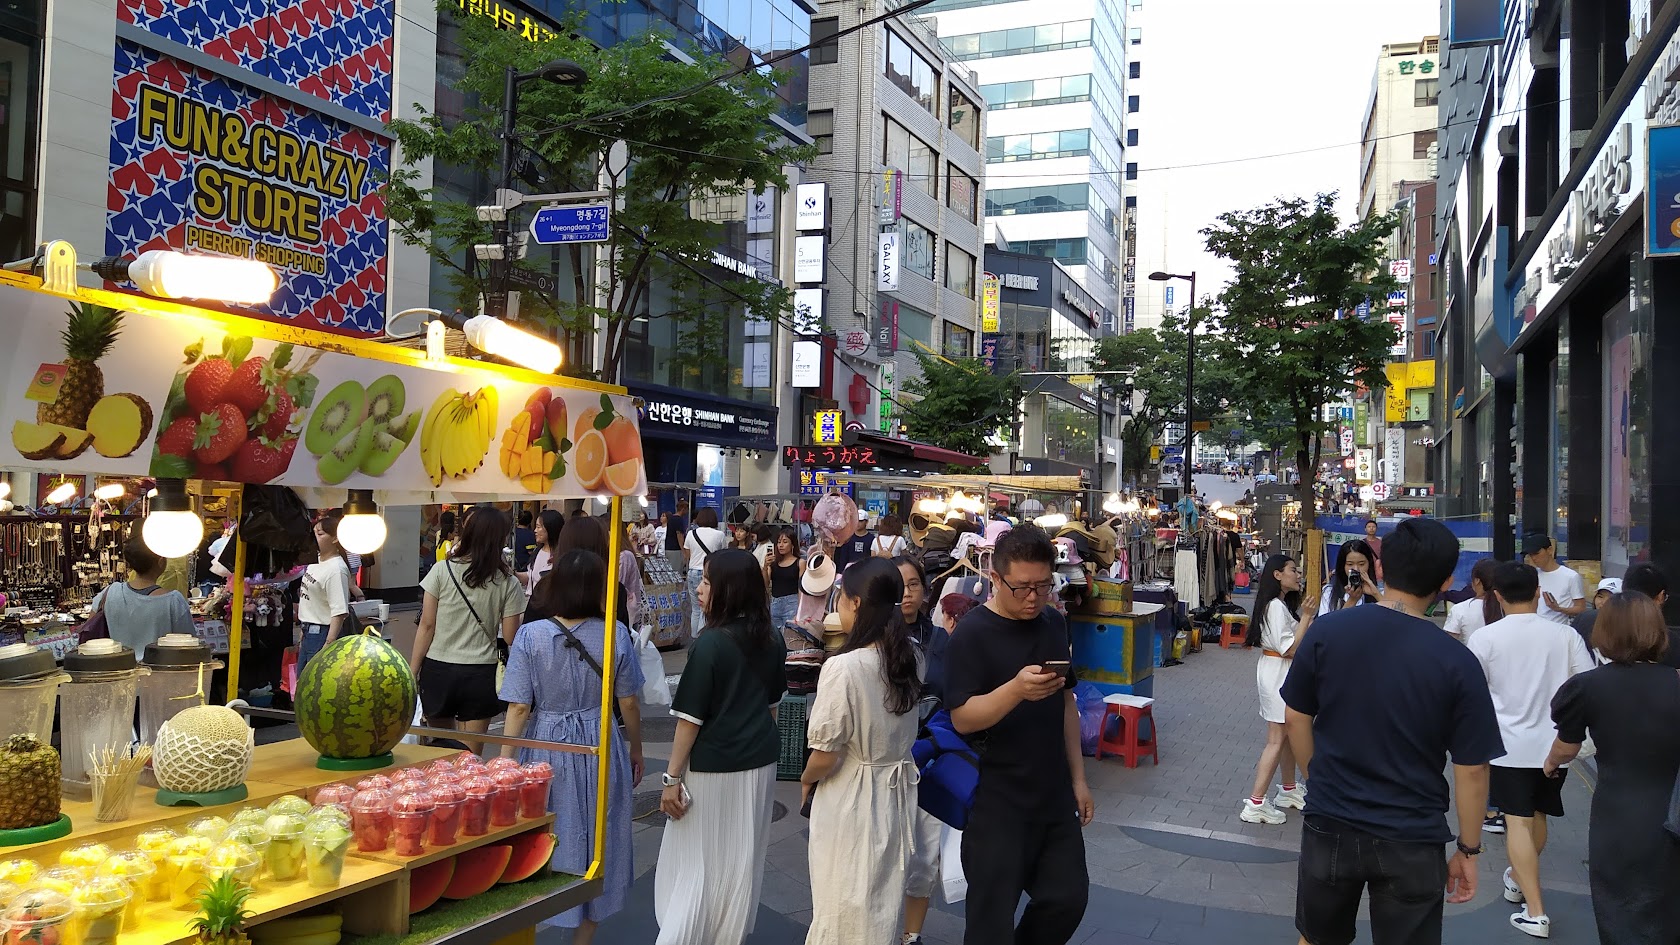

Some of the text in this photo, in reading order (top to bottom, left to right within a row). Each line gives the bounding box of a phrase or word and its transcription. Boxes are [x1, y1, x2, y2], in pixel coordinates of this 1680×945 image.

[140, 85, 367, 202] FUN&CRAZY
[195, 164, 321, 244] STORE
[576, 208, 607, 221] 명동7길
[550, 222, 606, 233] Myeongdong 7-gil
[188, 226, 324, 274] PIERROT SHOPPING
[737, 261, 758, 279] BANK
[883, 243, 892, 285] GALAXY
[986, 289, 997, 320] 부동산
[1388, 291, 1406, 300] MK
[846, 332, 865, 352] 藥
[880, 326, 890, 344] Nail
[796, 352, 801, 362] 2
[648, 401, 693, 426] 신한은행
[694, 409, 735, 424] SHINHAN BANK
[786, 447, 877, 464] りょうがえ
[1373, 484, 1387, 498] 약
[868, 505, 886, 516] SIM
